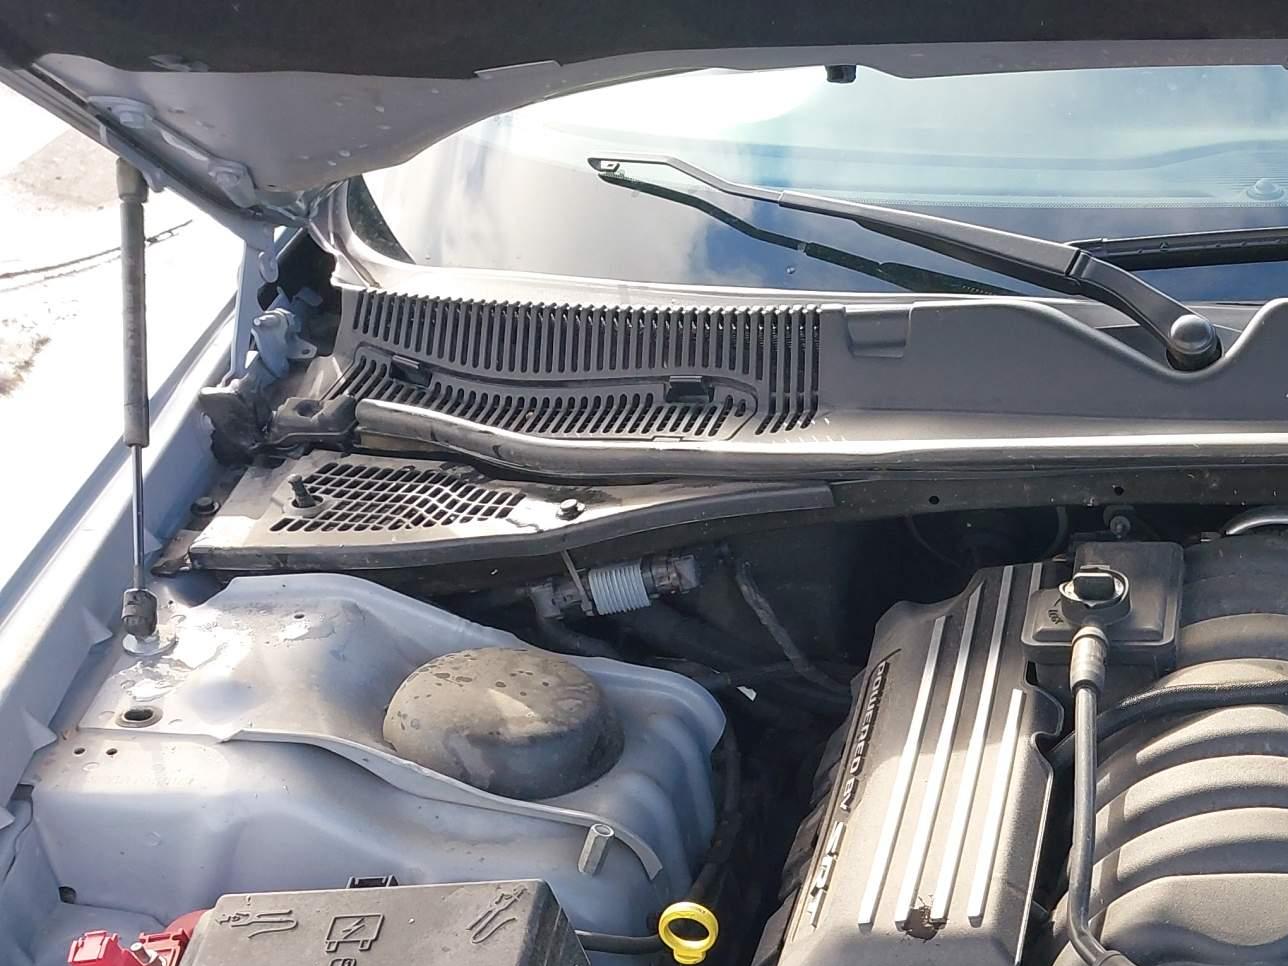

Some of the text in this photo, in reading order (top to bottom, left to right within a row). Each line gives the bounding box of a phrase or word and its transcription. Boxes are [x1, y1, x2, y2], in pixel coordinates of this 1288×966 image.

[808, 661, 888, 928] POWERED BY SRT
